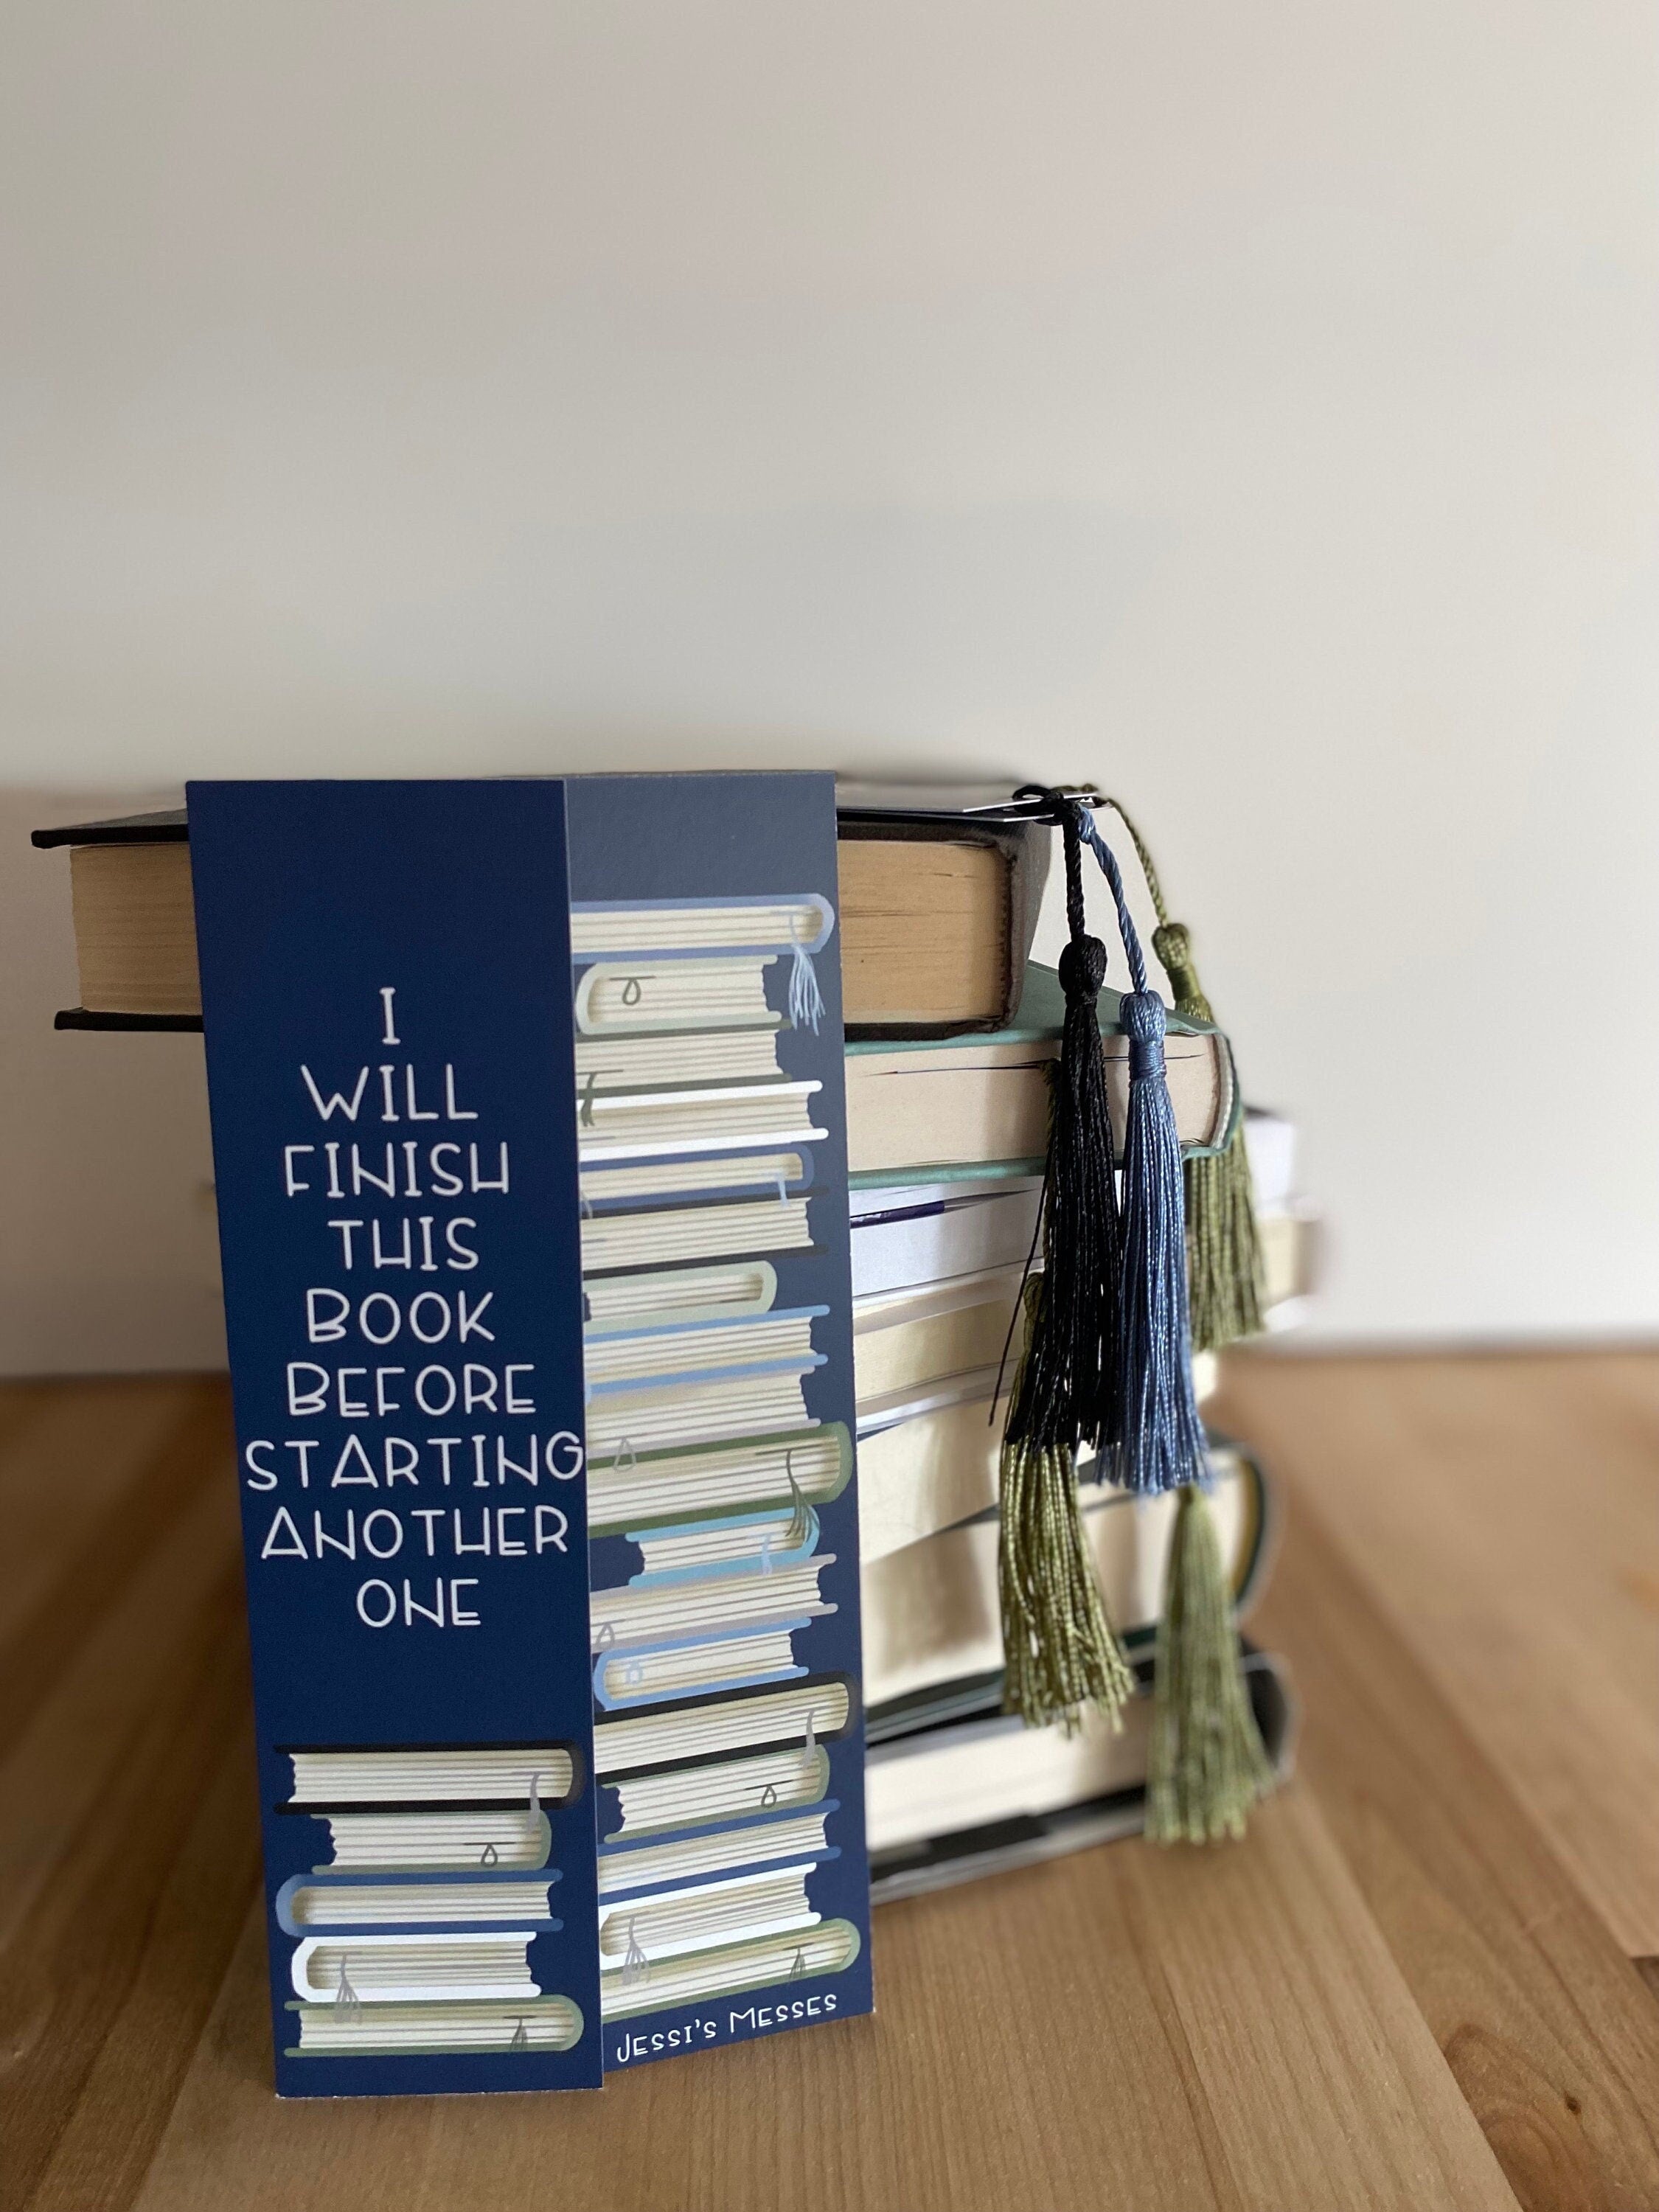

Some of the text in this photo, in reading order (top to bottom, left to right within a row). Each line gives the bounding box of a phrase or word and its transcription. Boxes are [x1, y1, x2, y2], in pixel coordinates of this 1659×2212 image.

[380, 987, 401, 1045] I
[301, 1063, 479, 1121] WILL
[285, 1141, 509, 1198] FINISH
[327, 1216, 479, 1271] THIS
[307, 1287, 495, 1344] BOOK
[287, 1362, 536, 1417] BEFORE
[246, 1430, 584, 1491] STARTING
[261, 1505, 568, 1560] ANOTHER
[357, 1577, 481, 1628] ONE
[616, 1994, 837, 2062] JESSI'S MESSES
